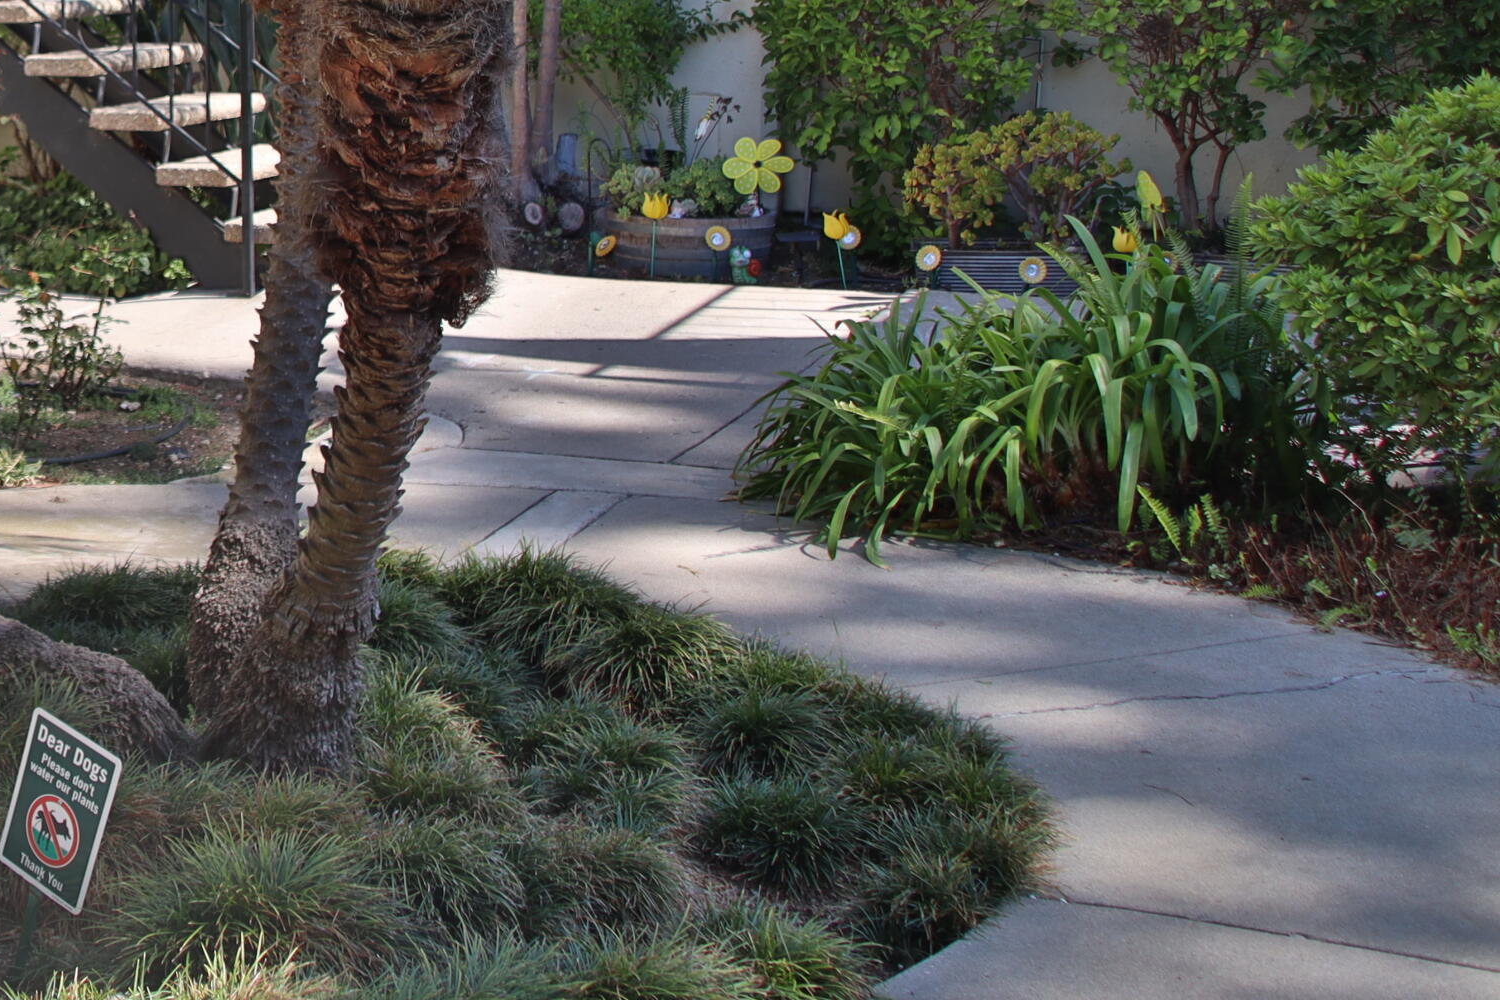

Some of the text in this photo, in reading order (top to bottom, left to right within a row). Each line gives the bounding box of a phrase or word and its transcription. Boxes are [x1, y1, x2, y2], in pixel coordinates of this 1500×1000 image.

[37, 724, 108, 783] Dear Dogs
[41, 752, 95, 797] Please don't
[30, 761, 99, 815] water our plants
[20, 852, 64, 892] Thank You
